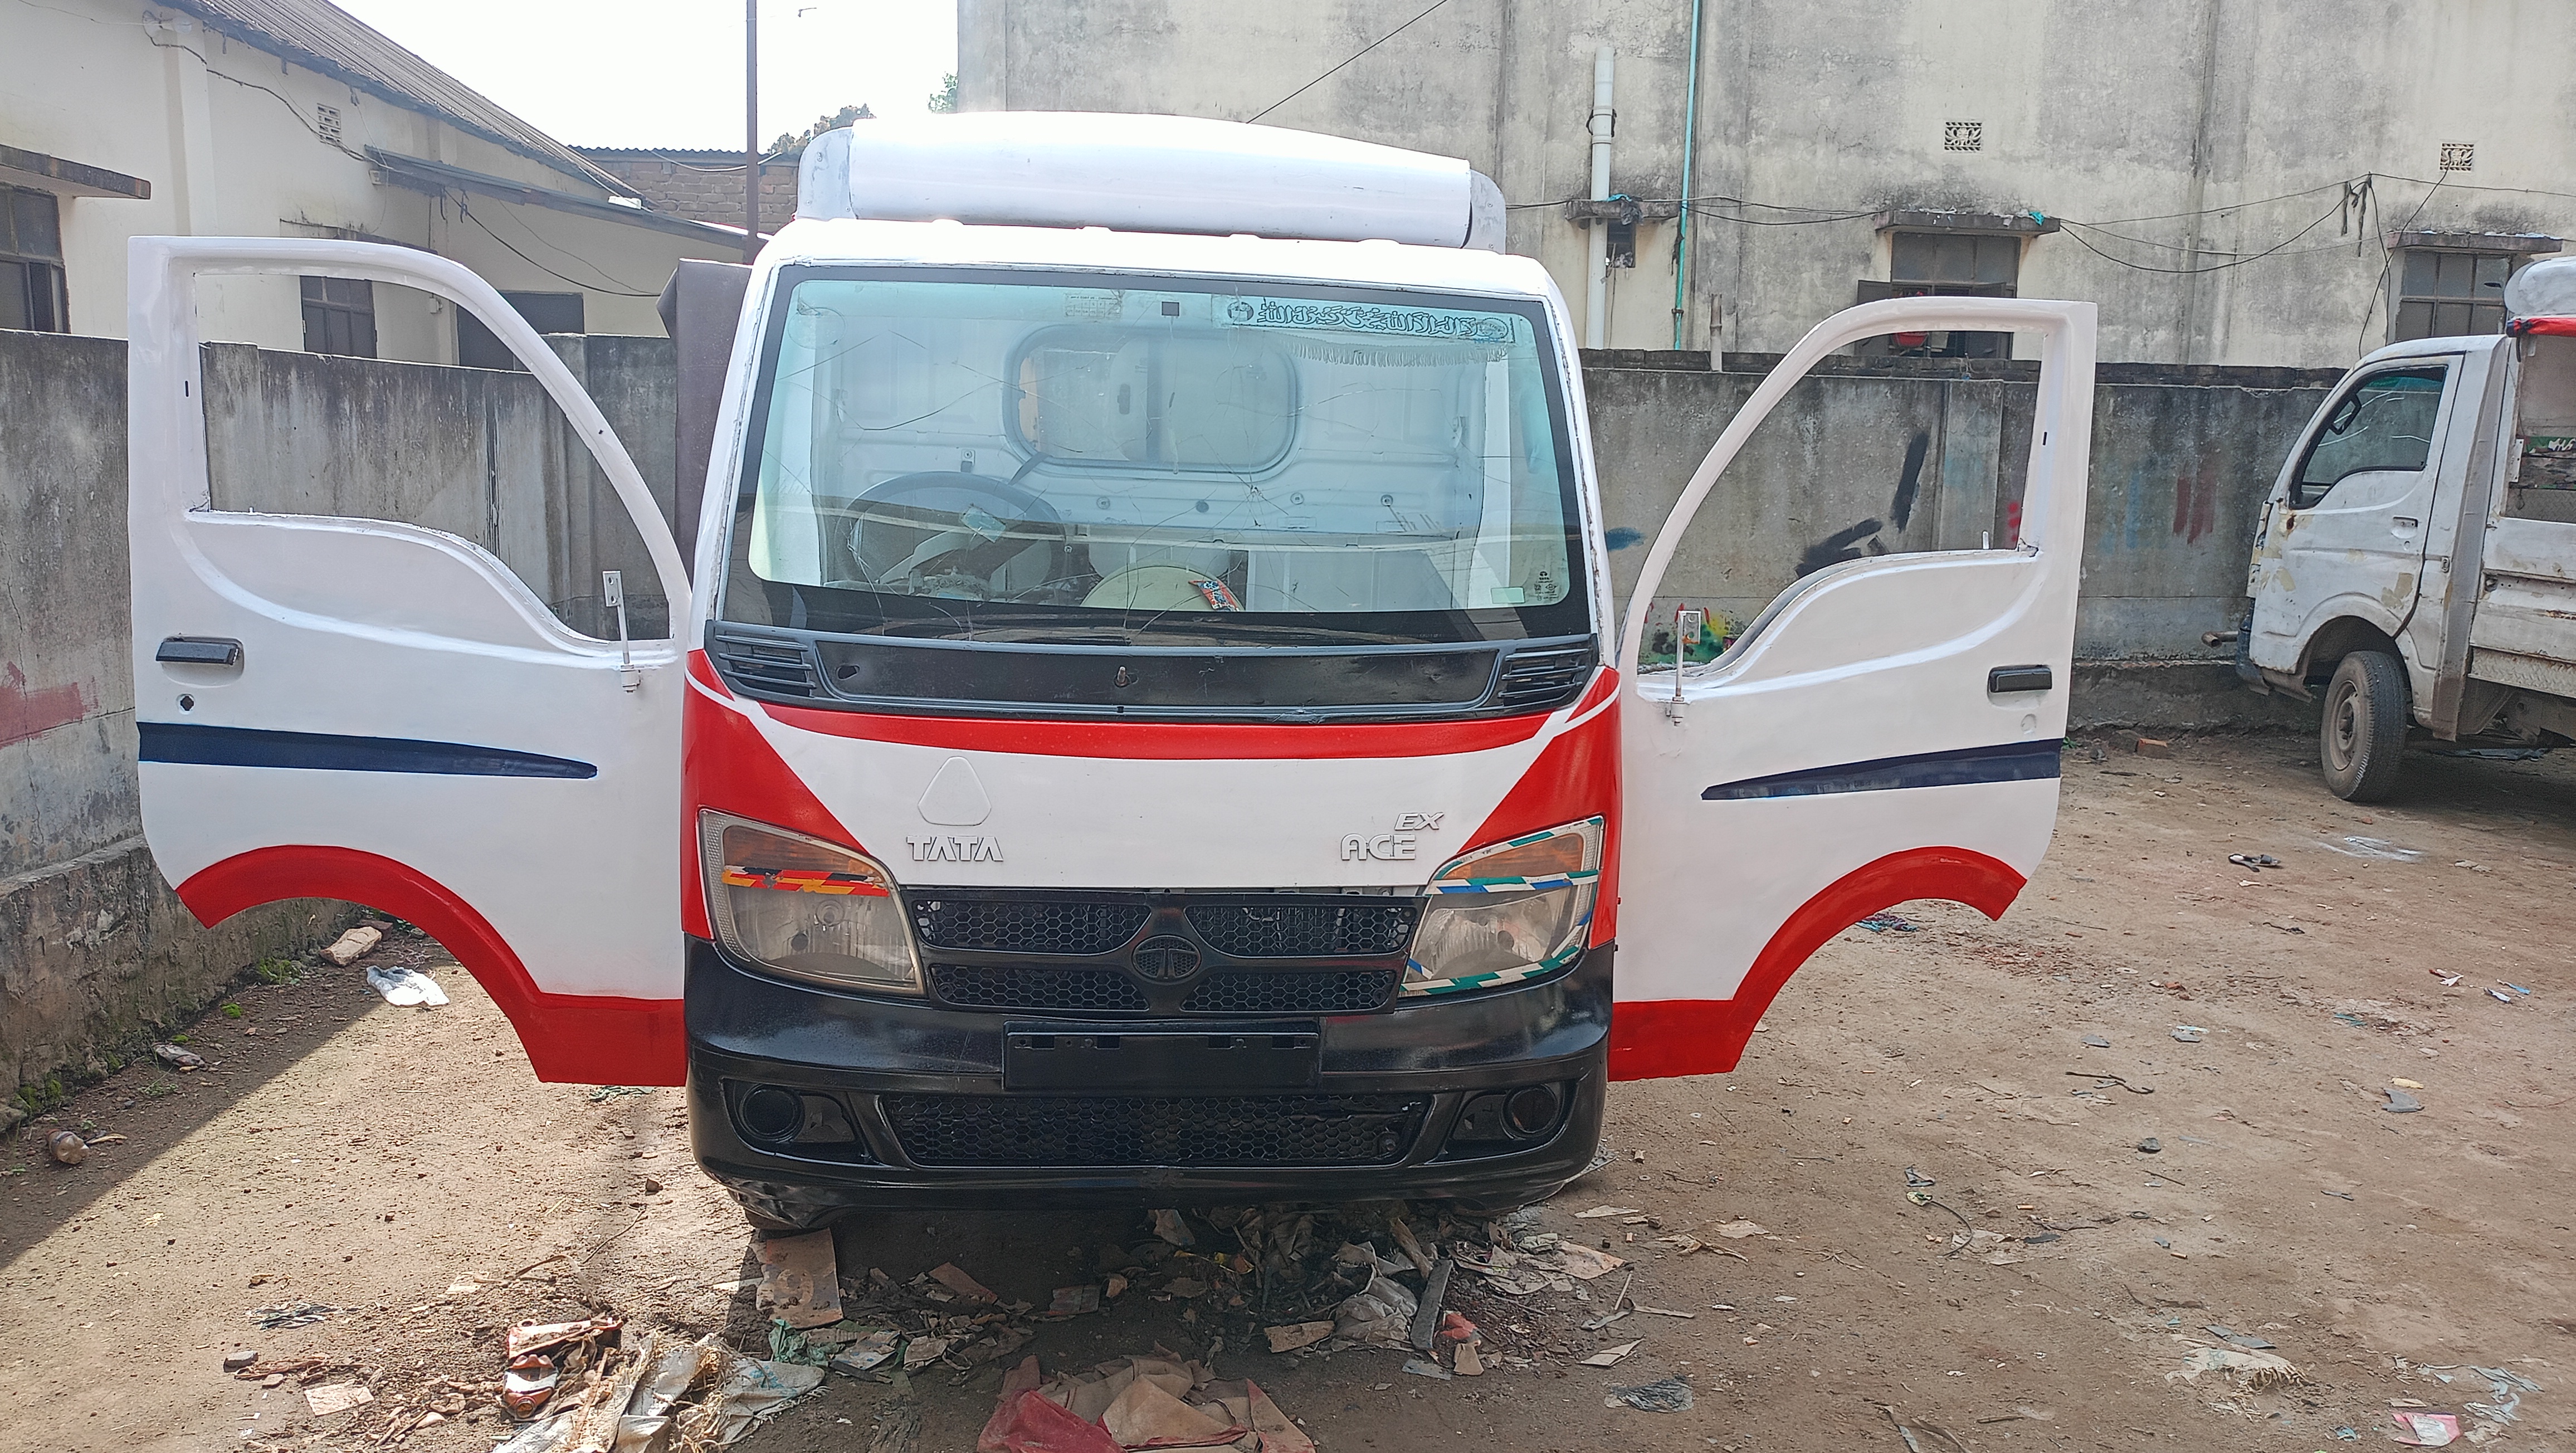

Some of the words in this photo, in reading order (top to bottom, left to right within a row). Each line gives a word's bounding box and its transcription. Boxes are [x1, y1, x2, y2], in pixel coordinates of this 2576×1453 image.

[1394, 812, 1444, 831] EX
[906, 835, 1003, 862] TATA
[1341, 833, 1416, 861] ACE
